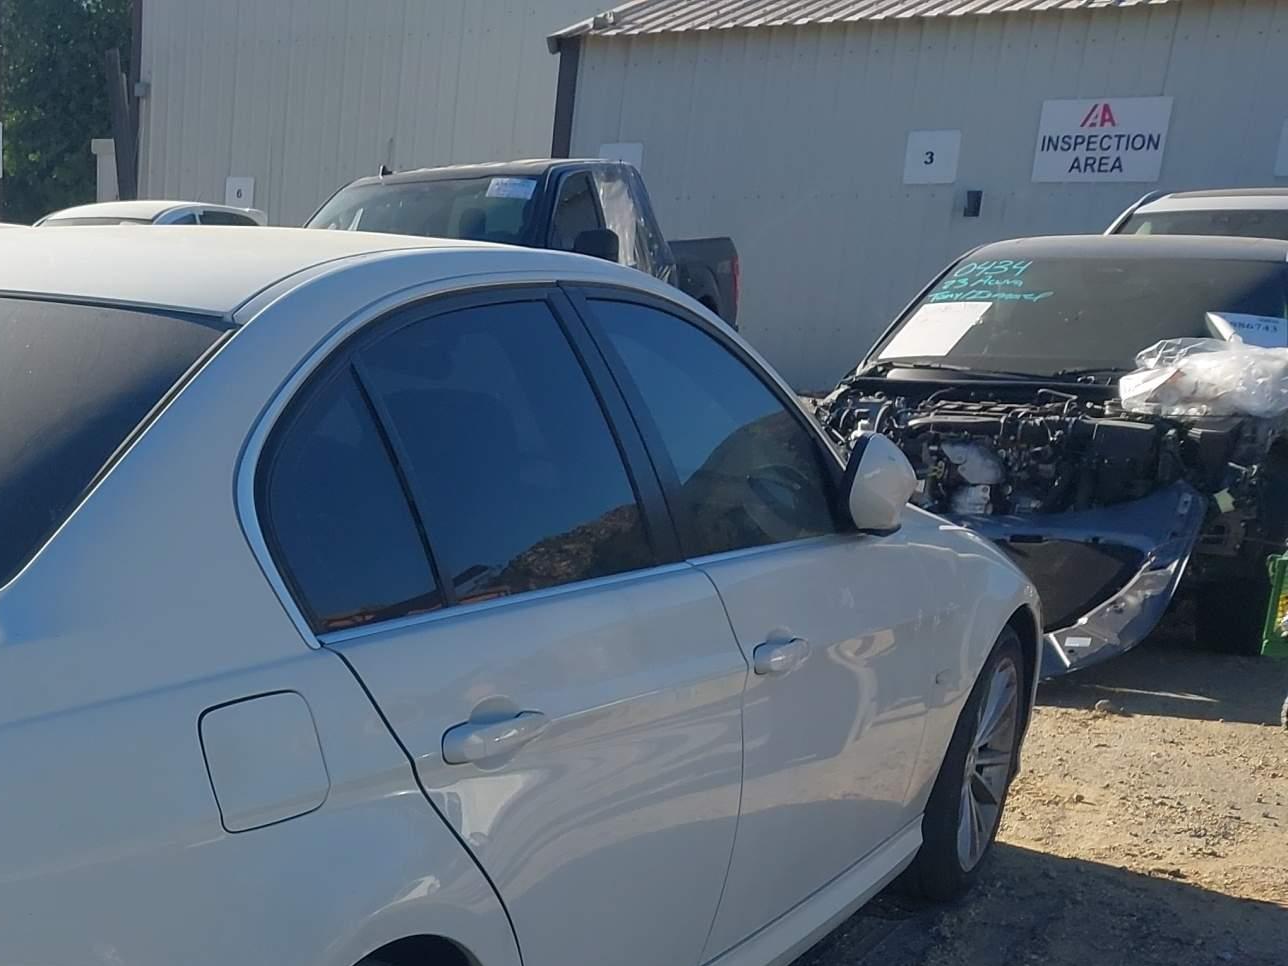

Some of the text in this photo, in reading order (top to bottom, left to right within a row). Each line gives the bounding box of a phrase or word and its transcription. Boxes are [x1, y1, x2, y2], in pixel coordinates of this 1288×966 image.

[1041, 133, 1161, 152] INSPECTION
[923, 151, 935, 166] 3
[1068, 156, 1124, 174] AREA
[236, 188, 243, 199] 6
[953, 260, 1033, 277] 0434
